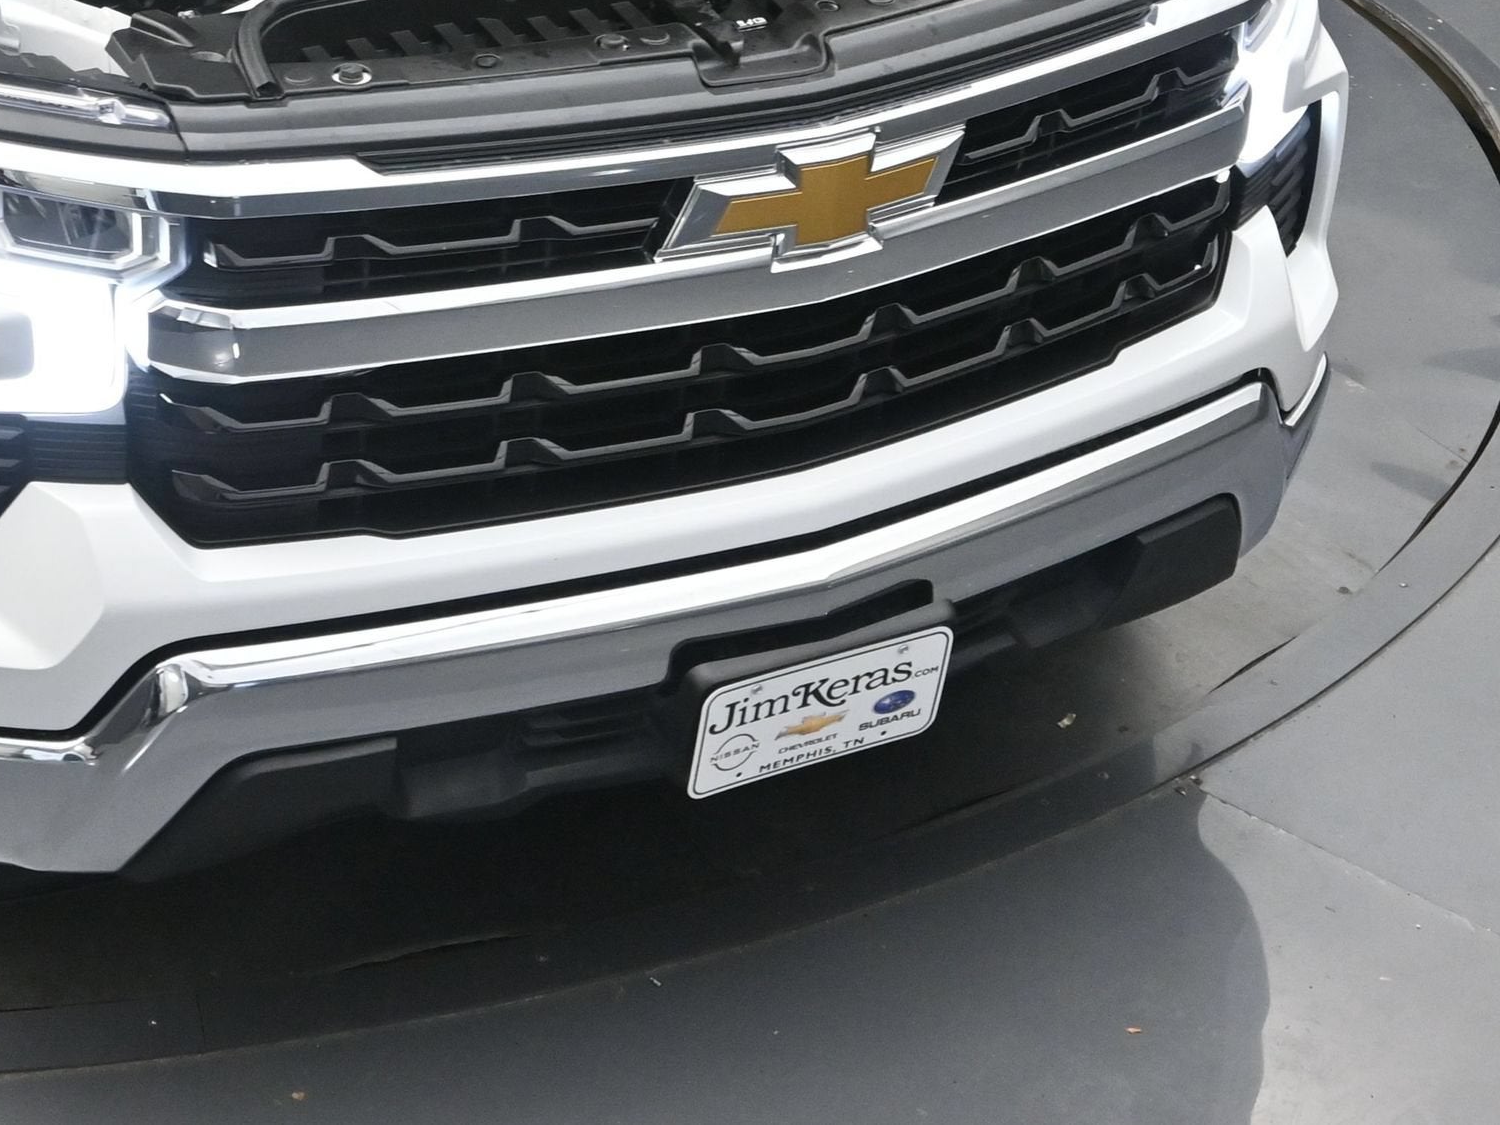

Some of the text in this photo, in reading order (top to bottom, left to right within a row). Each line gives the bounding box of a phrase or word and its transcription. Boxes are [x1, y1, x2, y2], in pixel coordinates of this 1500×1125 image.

[858, 708, 922, 731] SUBARU
[709, 742, 761, 764] NISSAN
[758, 736, 865, 774] MEMPHIS, TN
[777, 732, 839, 755] CHEVROLET
